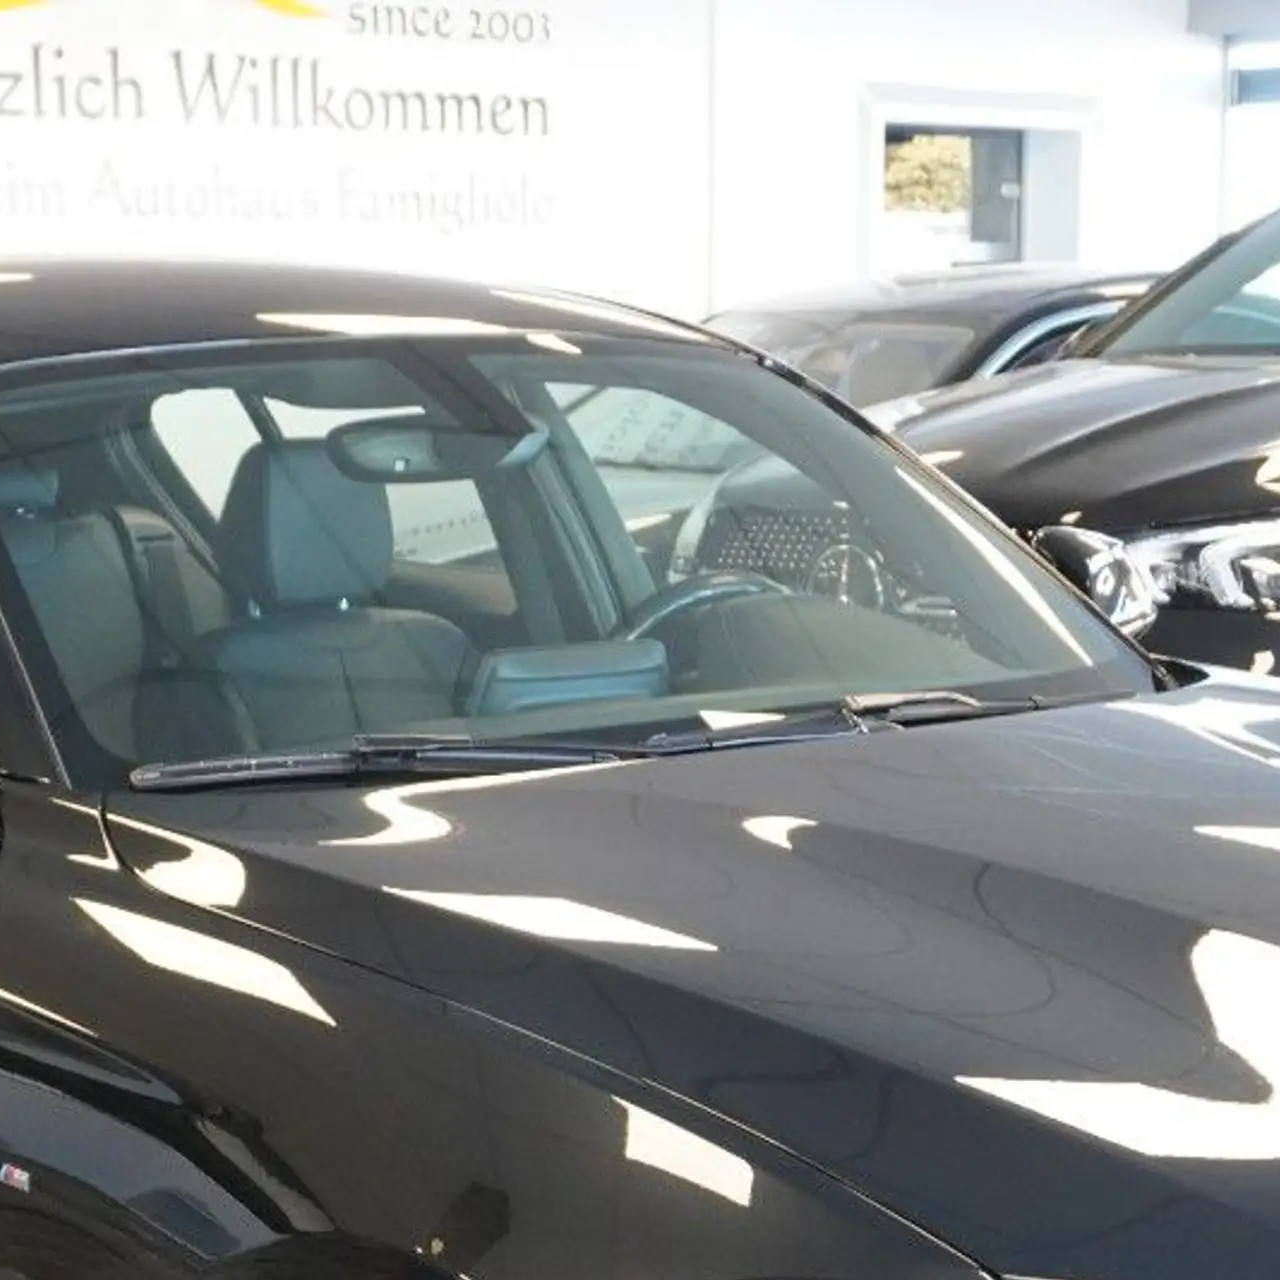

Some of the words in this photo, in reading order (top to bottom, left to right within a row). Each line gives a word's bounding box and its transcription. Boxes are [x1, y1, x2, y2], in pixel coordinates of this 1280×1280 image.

[348, 1, 451, 38] since
[170, 49, 549, 136] Willkommen
[91, 152, 321, 219] Autohaus
